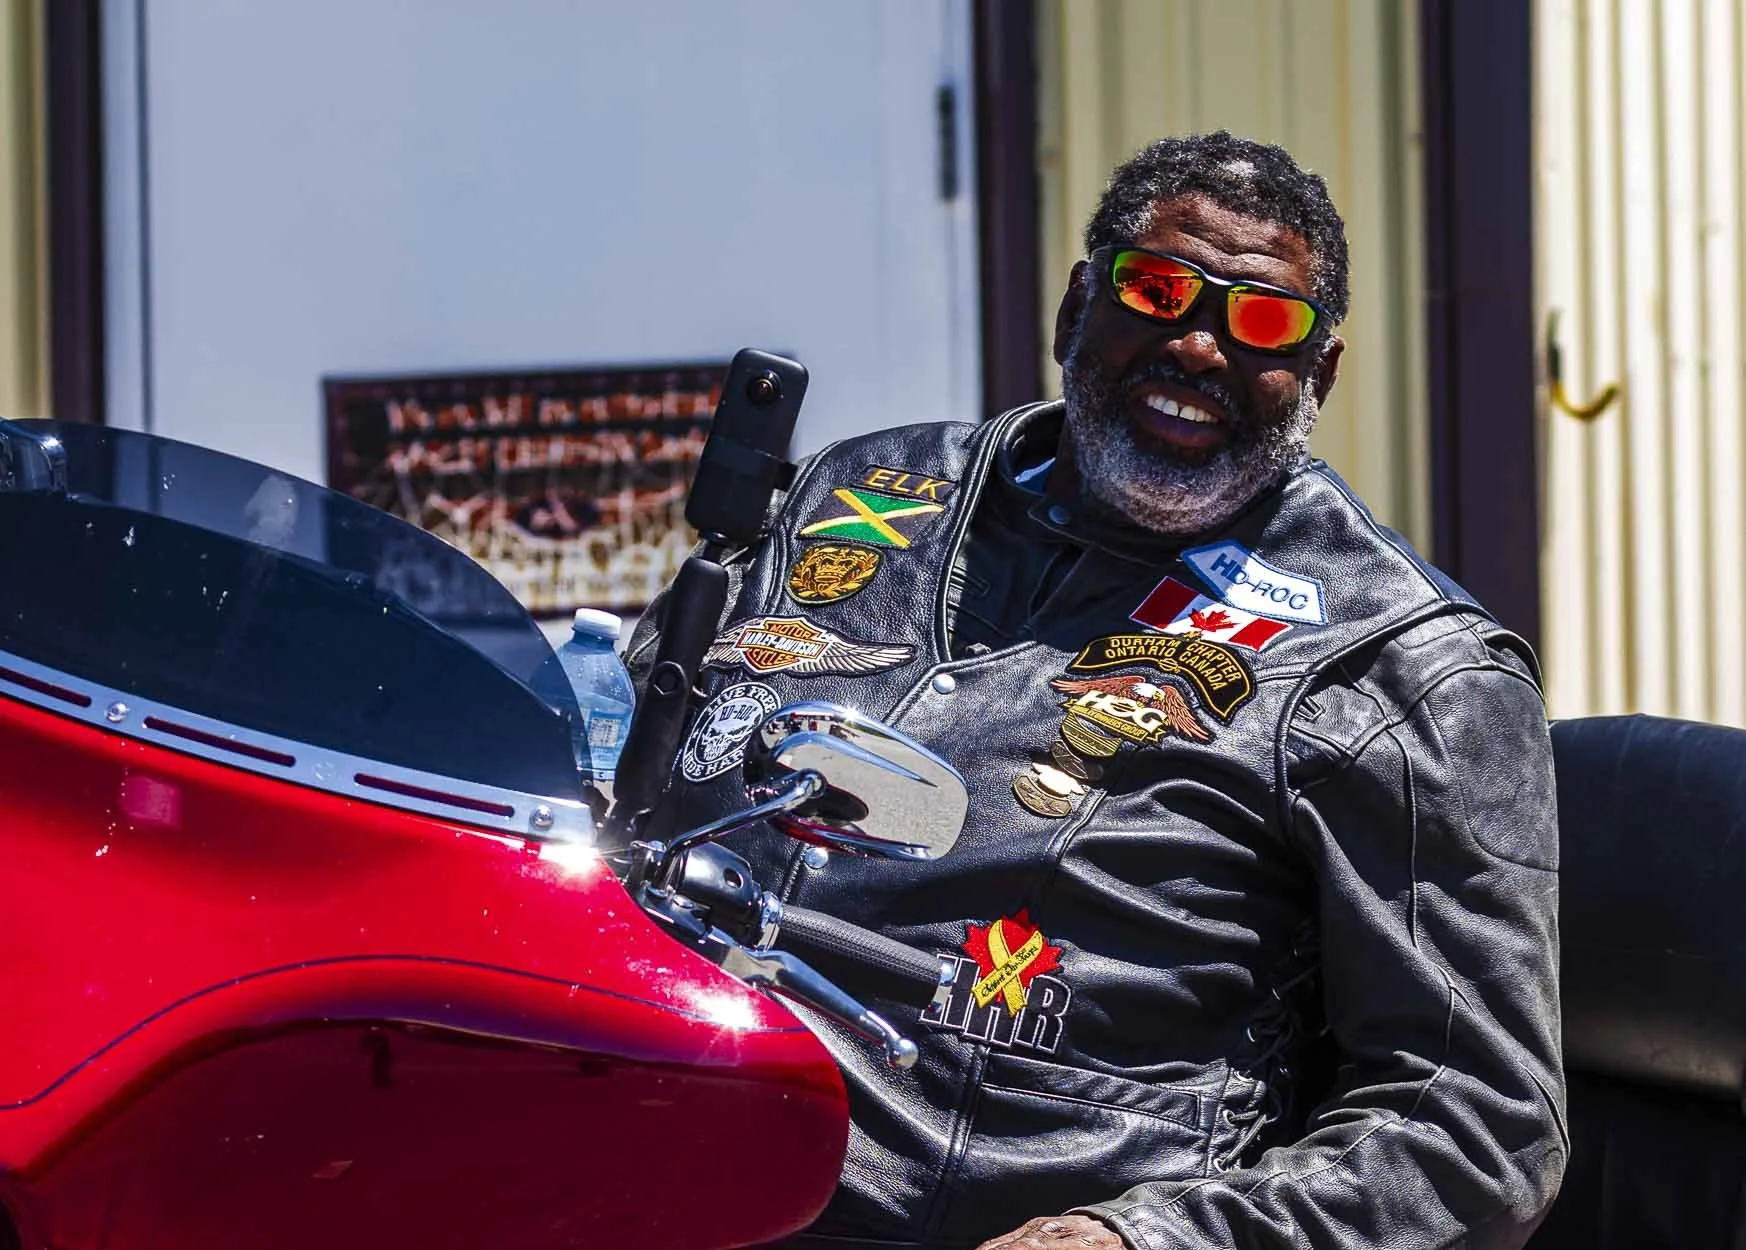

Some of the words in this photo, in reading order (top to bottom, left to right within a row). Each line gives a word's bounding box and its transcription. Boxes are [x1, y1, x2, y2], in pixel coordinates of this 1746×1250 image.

[866, 468, 948, 499] ELK
[1210, 553, 1310, 609] HD-ROC
[741, 631, 823, 656] HARLEY-DAVIDSON
[769, 624, 812, 639] MOTOR
[752, 648, 794, 666] CYCLES
[1105, 645, 1176, 659] ONTARIO
[1179, 652, 1228, 691] CANADA
[1110, 638, 1181, 648] DURHAM
[1186, 643, 1242, 683] CHAPTER
[707, 686, 746, 715] LIVE
[746, 686, 777, 714] FREE
[1121, 723, 1145, 738] GROUP
[705, 750, 745, 776] HAR
